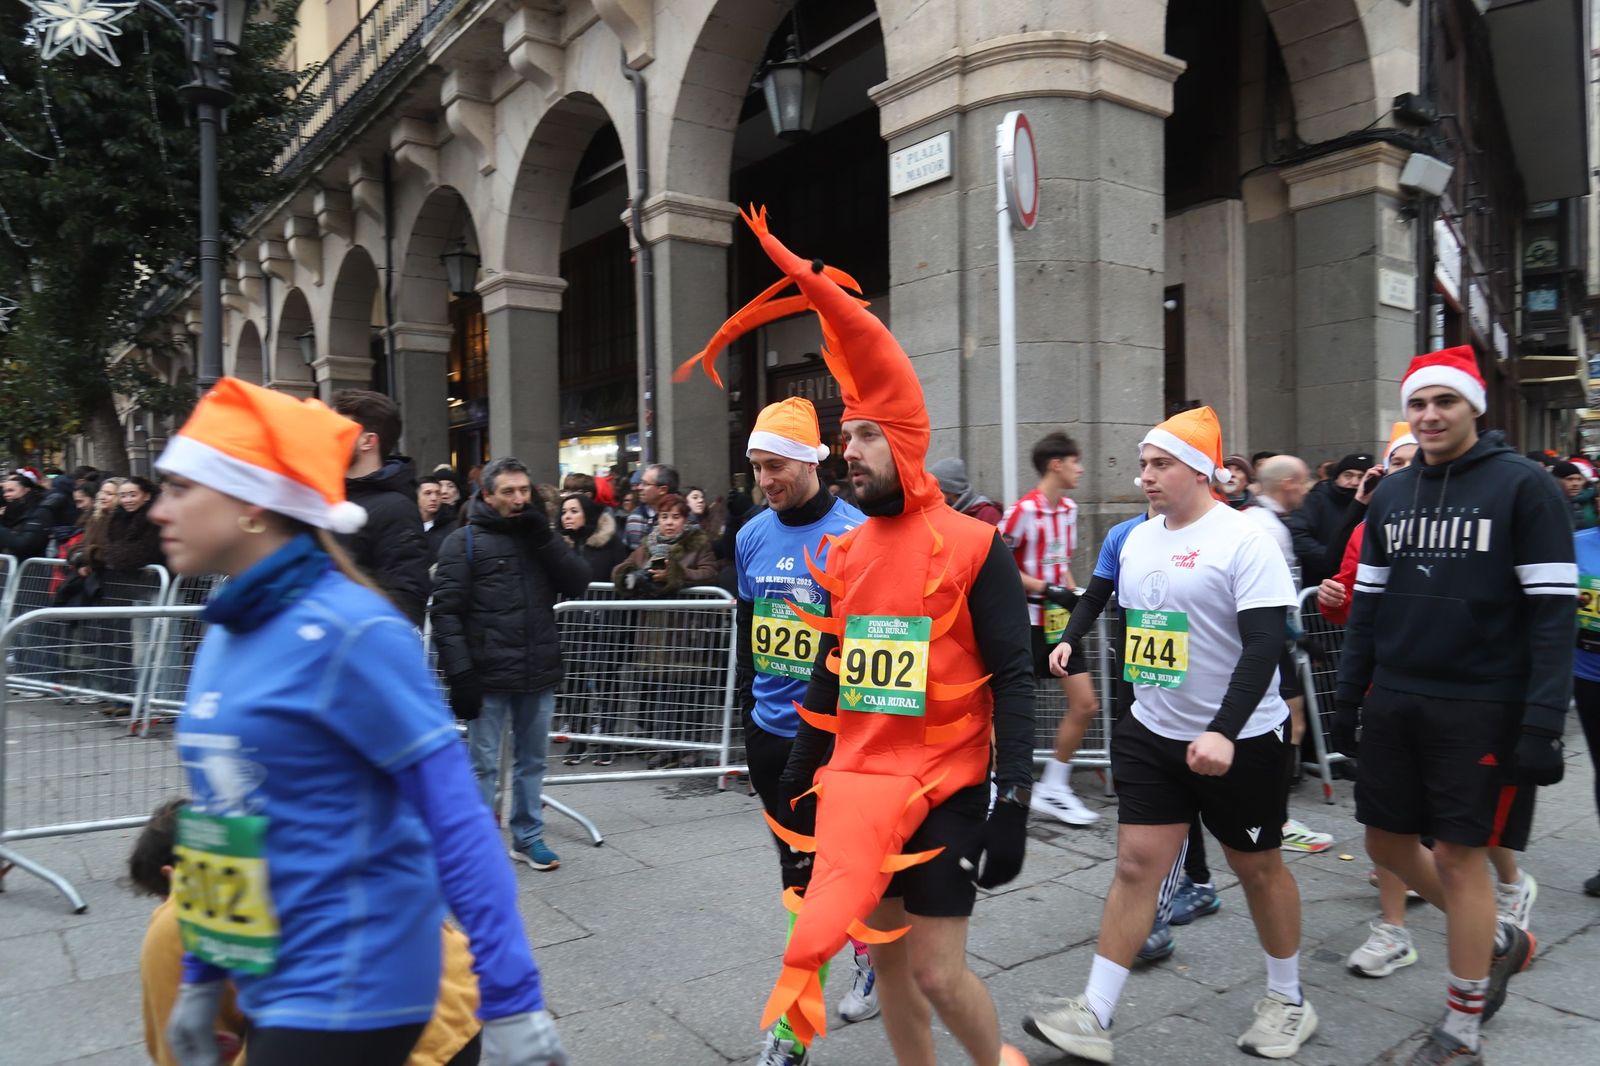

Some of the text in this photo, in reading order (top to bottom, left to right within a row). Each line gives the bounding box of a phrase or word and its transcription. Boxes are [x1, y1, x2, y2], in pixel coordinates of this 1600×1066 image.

[906, 142, 943, 165] PLAZA
[906, 159, 944, 183] MAYOR
[776, 557, 794, 570] 46
[885, 627, 909, 635] RURAL
[756, 624, 812, 660] 926
[1130, 634, 1177, 668] 744
[770, 661, 814, 676] CAJA RURA
[846, 648, 915, 688] 902
[1140, 670, 1157, 680] CAJA
[863, 694, 919, 709] CAJA RURAL
